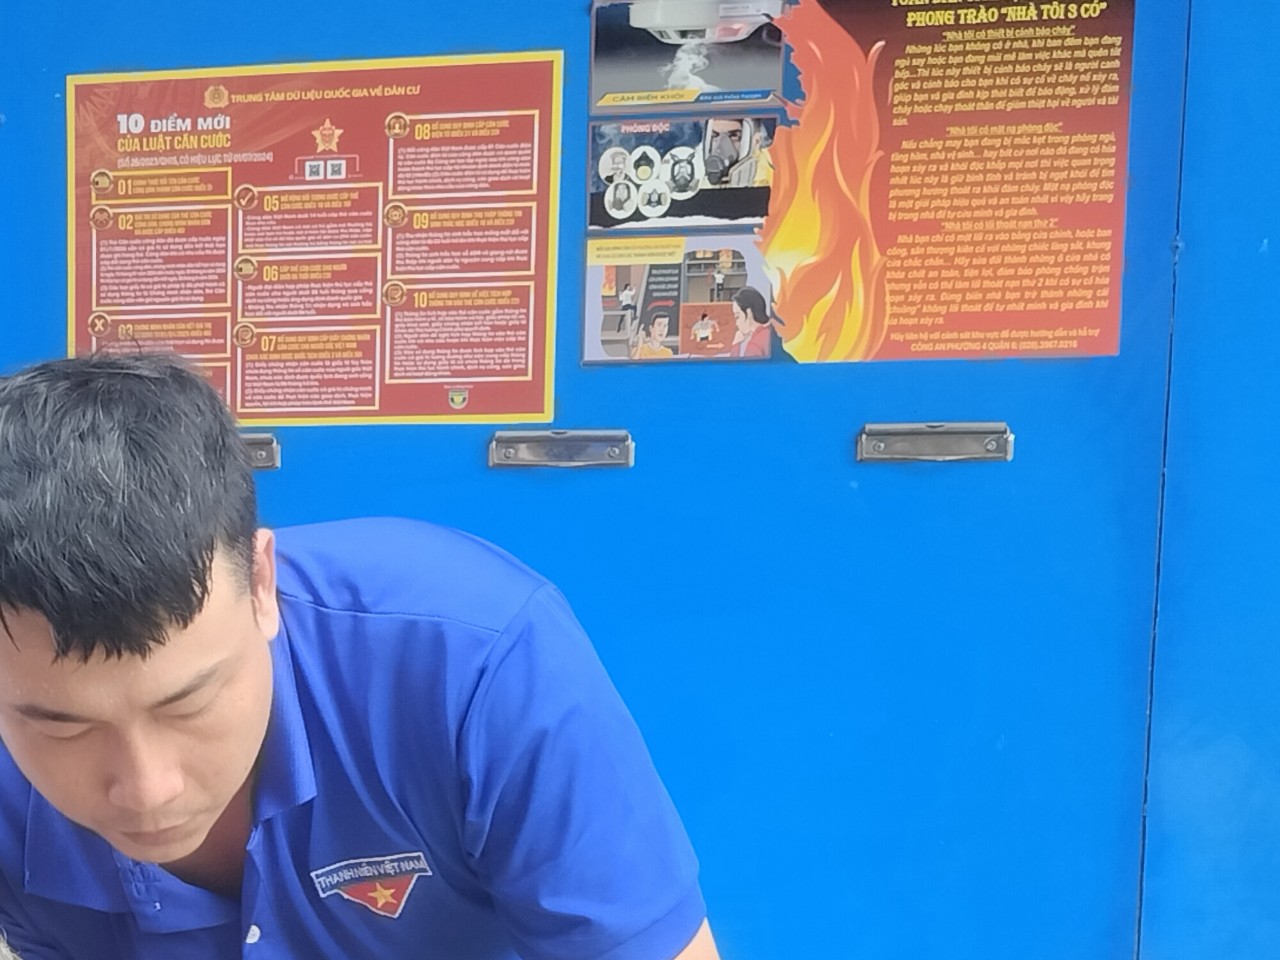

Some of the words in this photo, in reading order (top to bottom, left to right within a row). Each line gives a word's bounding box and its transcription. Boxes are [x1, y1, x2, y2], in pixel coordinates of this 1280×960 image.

[906, 10, 955, 27] PHONG
[957, 4, 999, 25] TRÀO
[1040, 1, 1066, 19] TÔI
[117, 113, 145, 134] 10
[150, 112, 192, 132] ĐIỂM
[197, 114, 231, 131] MỚI
[414, 123, 431, 140] 08
[117, 134, 141, 152] CỦA
[143, 134, 172, 153] LUẬT
[174, 133, 198, 149] CĂN
[200, 132, 231, 148] CƯỚC
[118, 179, 132, 195] 01
[263, 195, 279, 211] 05
[118, 214, 134, 230] 02
[413, 212, 429, 229] 09
[263, 265, 279, 282] 06
[413, 291, 428, 308] 10
[261, 335, 276, 352] 07
